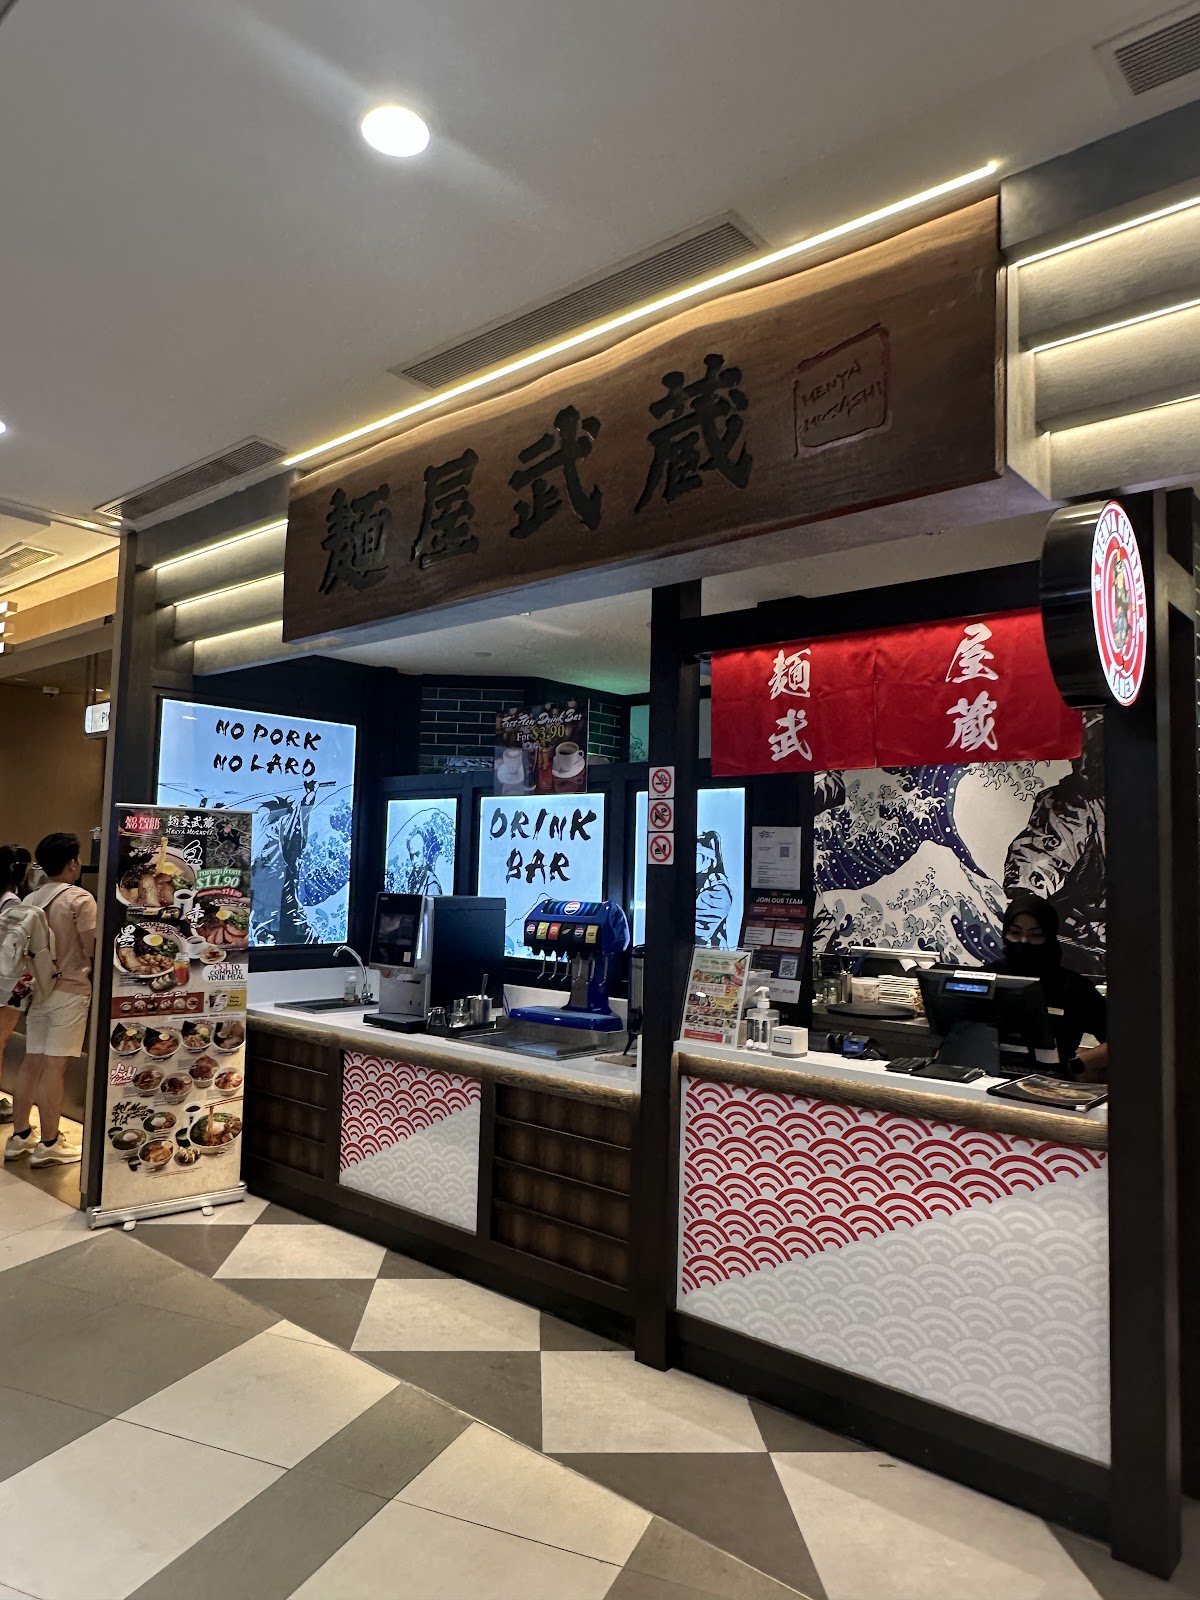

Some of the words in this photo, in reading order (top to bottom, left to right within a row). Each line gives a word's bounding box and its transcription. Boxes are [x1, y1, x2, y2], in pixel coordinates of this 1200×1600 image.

[215, 719, 245, 740] NO
[253, 723, 321, 751] PORK
[517, 732, 530, 742] For
[532, 724, 565, 740] $3.90
[213, 753, 243, 772] NO
[250, 753, 316, 777] LARD
[125, 816, 138, 824] NO
[489, 807, 597, 841] DRINK
[505, 847, 571, 885] BAR
[196, 875, 240, 890] $11.90
